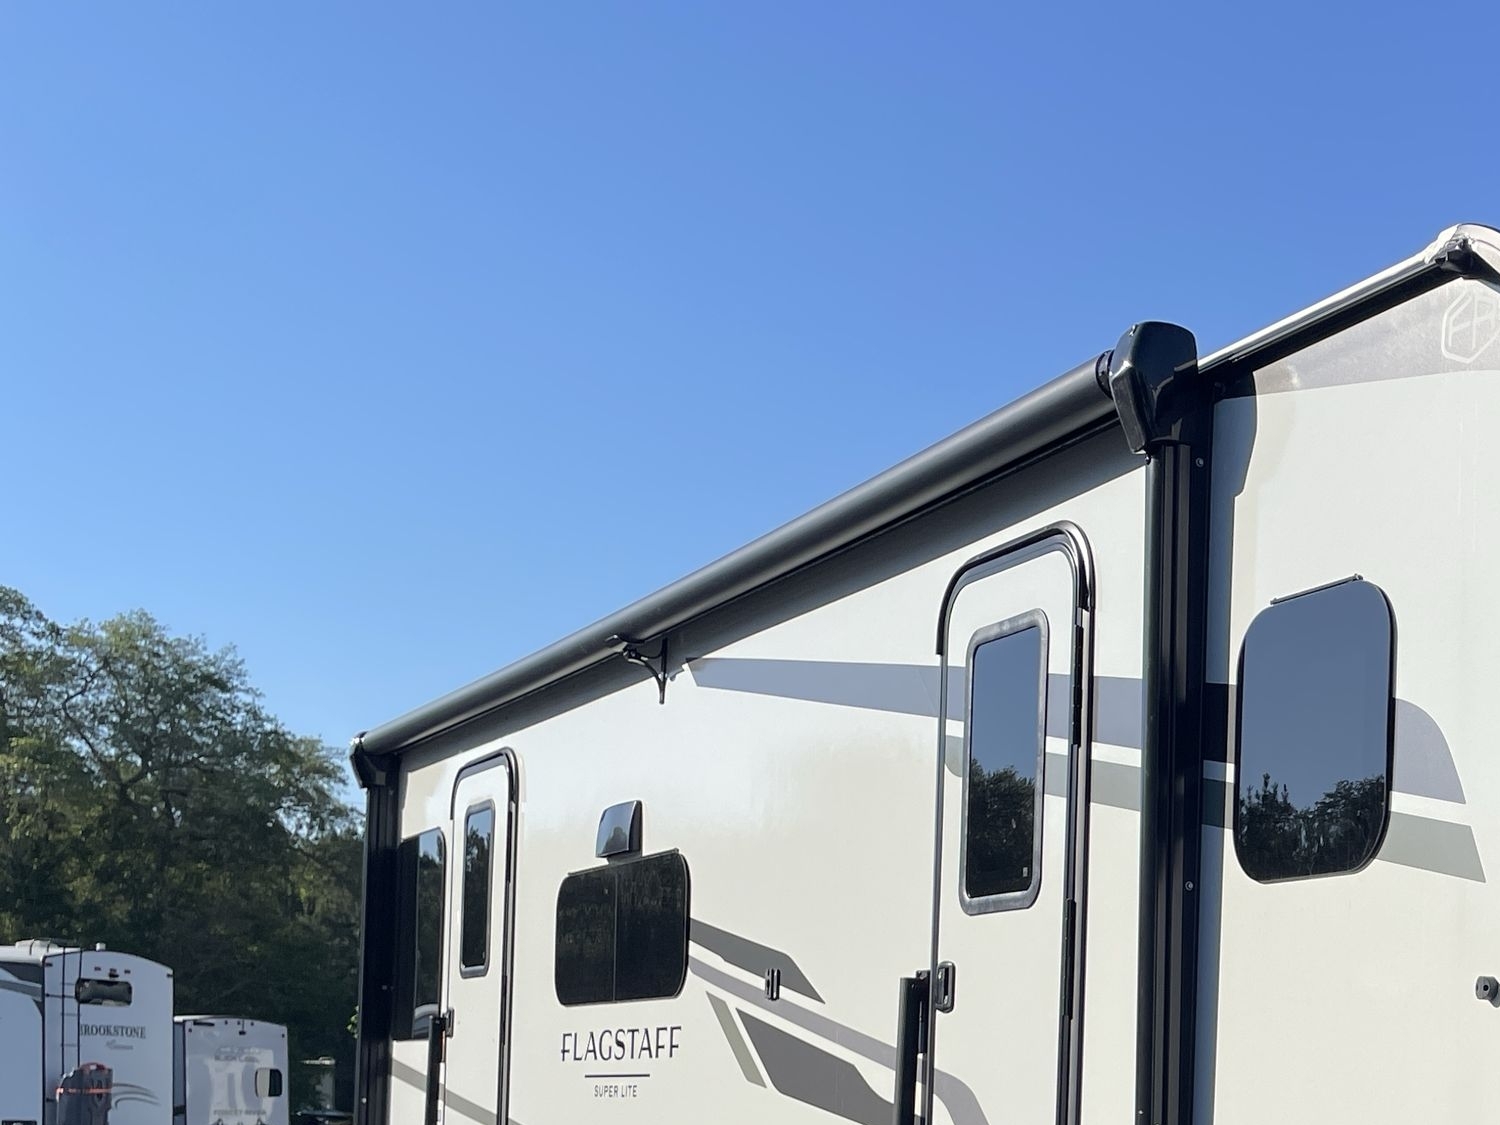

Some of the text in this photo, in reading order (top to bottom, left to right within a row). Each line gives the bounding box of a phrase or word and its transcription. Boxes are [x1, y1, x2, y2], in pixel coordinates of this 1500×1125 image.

[560, 1025, 682, 1062] FLAGSTAFF
[593, 1084, 638, 1098] SUPER LITE
